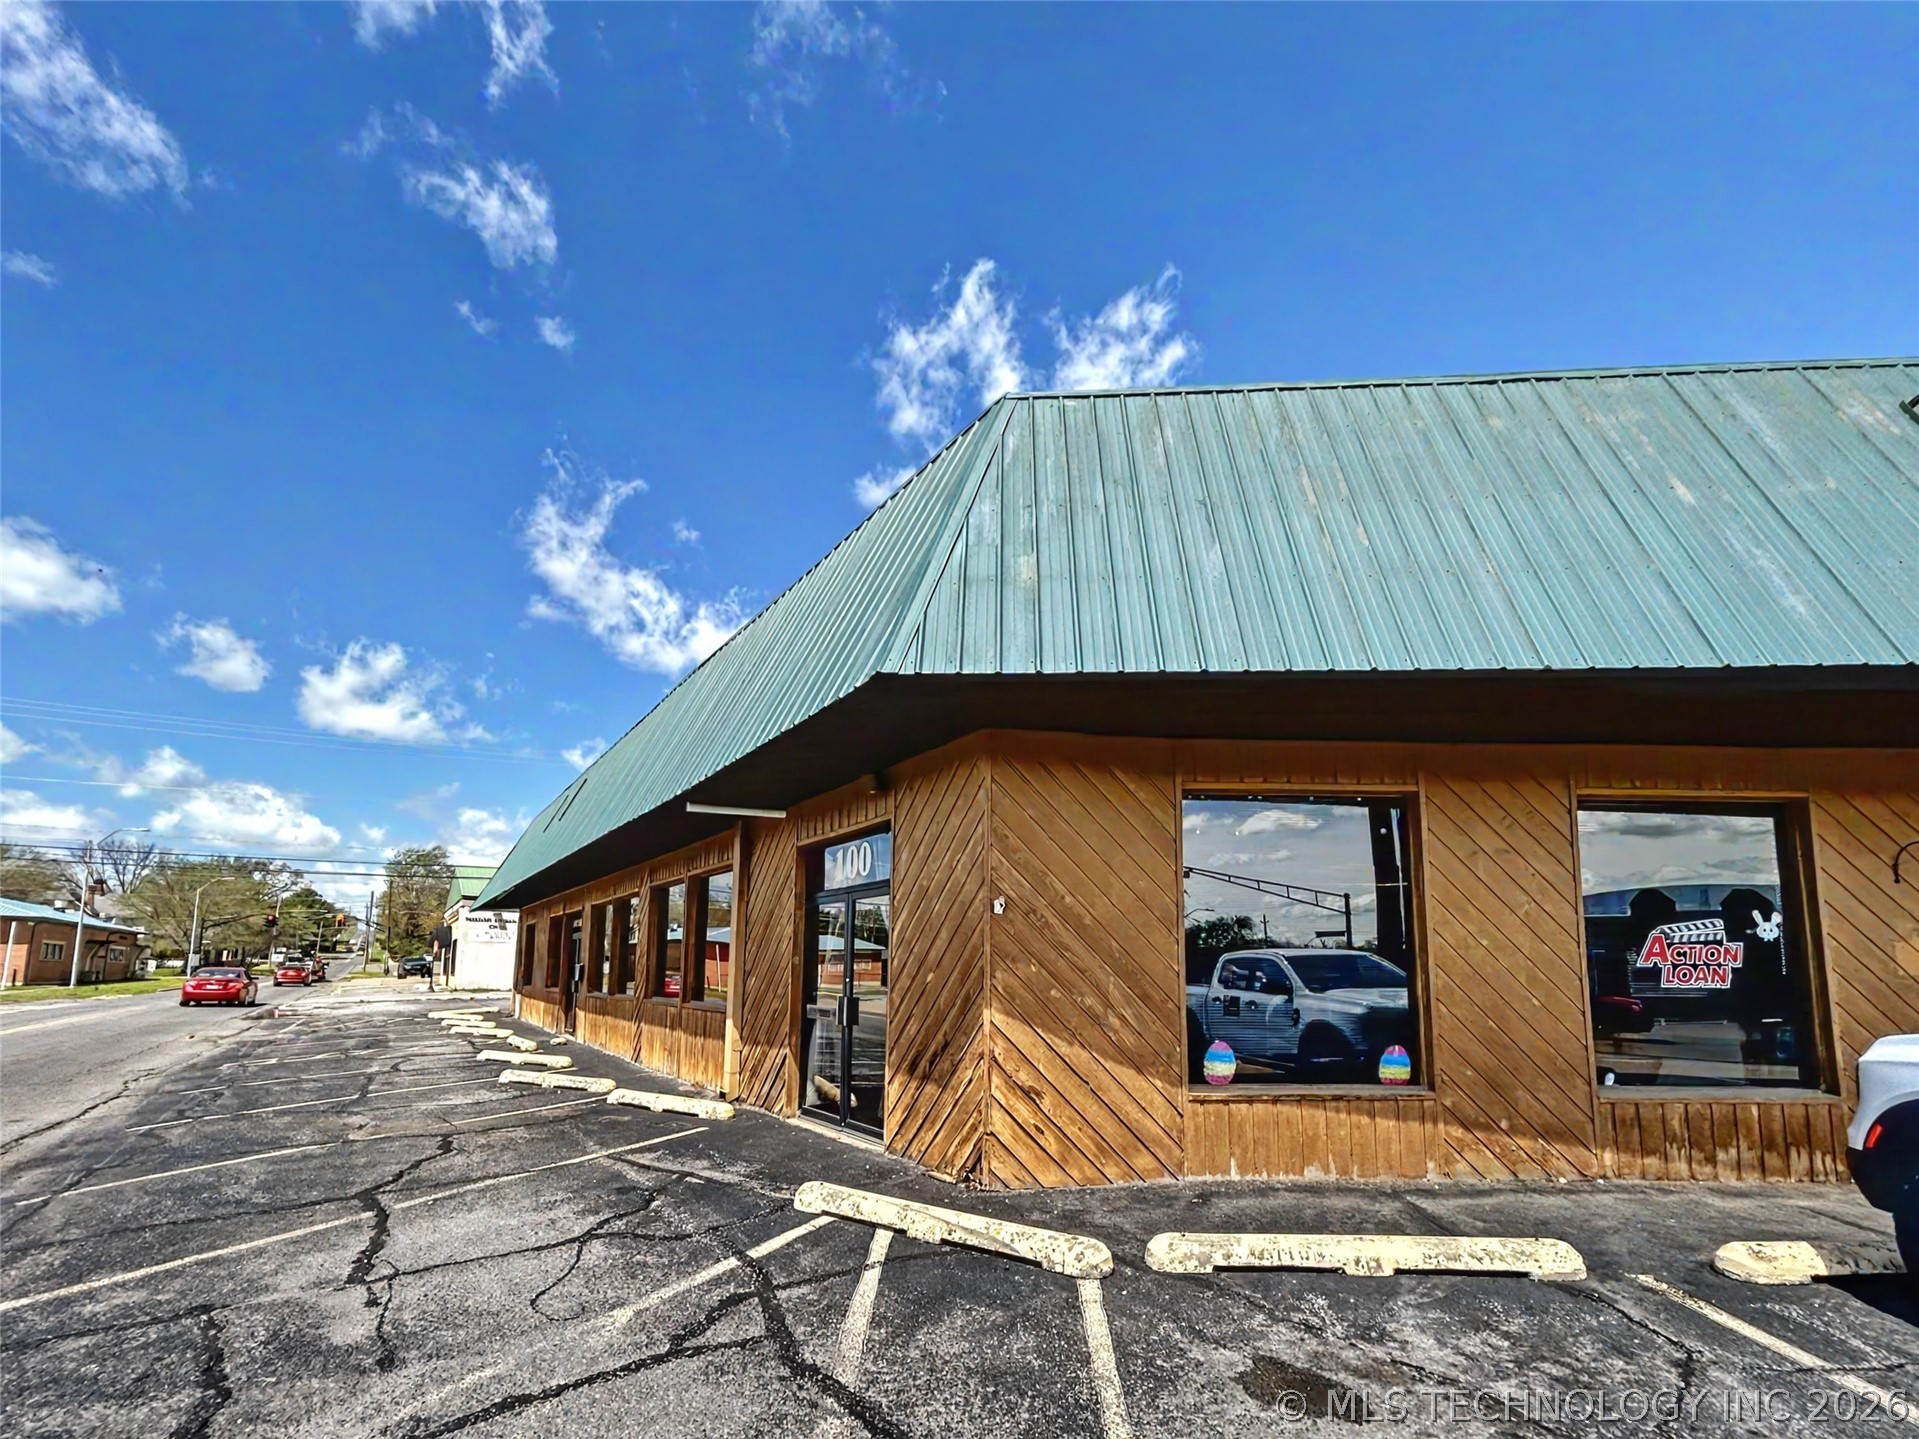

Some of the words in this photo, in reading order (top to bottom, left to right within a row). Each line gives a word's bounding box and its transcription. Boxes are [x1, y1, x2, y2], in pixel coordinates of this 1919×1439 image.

[836, 842, 872, 881] 100
[1642, 934, 1741, 965] ACTION
[1665, 966, 1728, 985] LOAN
